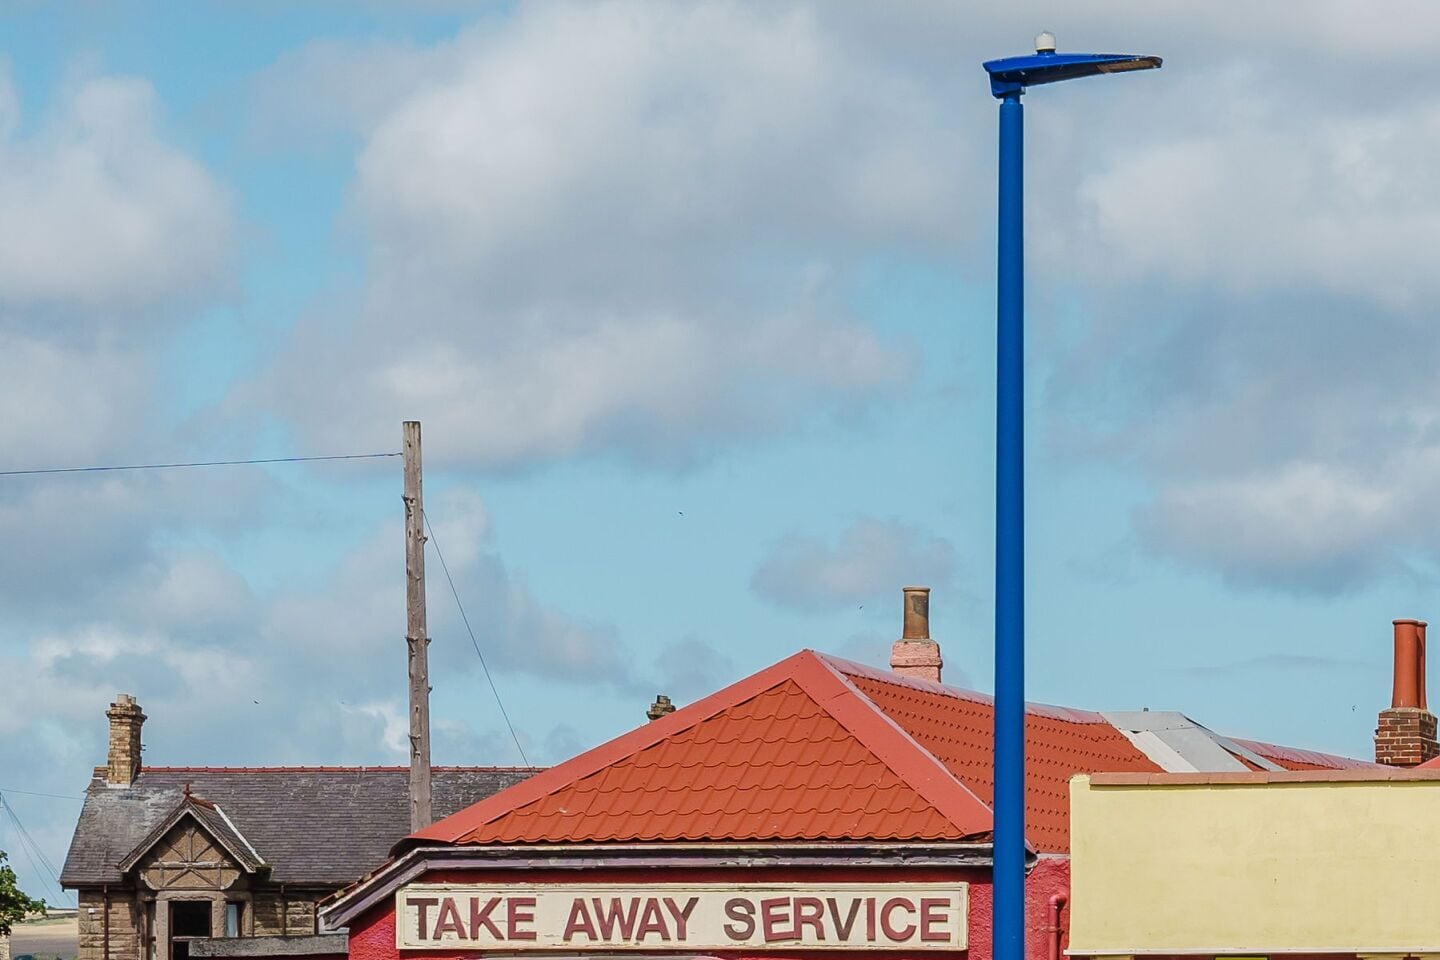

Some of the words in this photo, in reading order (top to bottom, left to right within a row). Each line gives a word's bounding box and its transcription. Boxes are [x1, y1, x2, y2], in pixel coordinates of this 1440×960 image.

[406, 897, 538, 942] TAKE
[563, 896, 700, 942] AWAY
[723, 896, 952, 943] SERVICE
